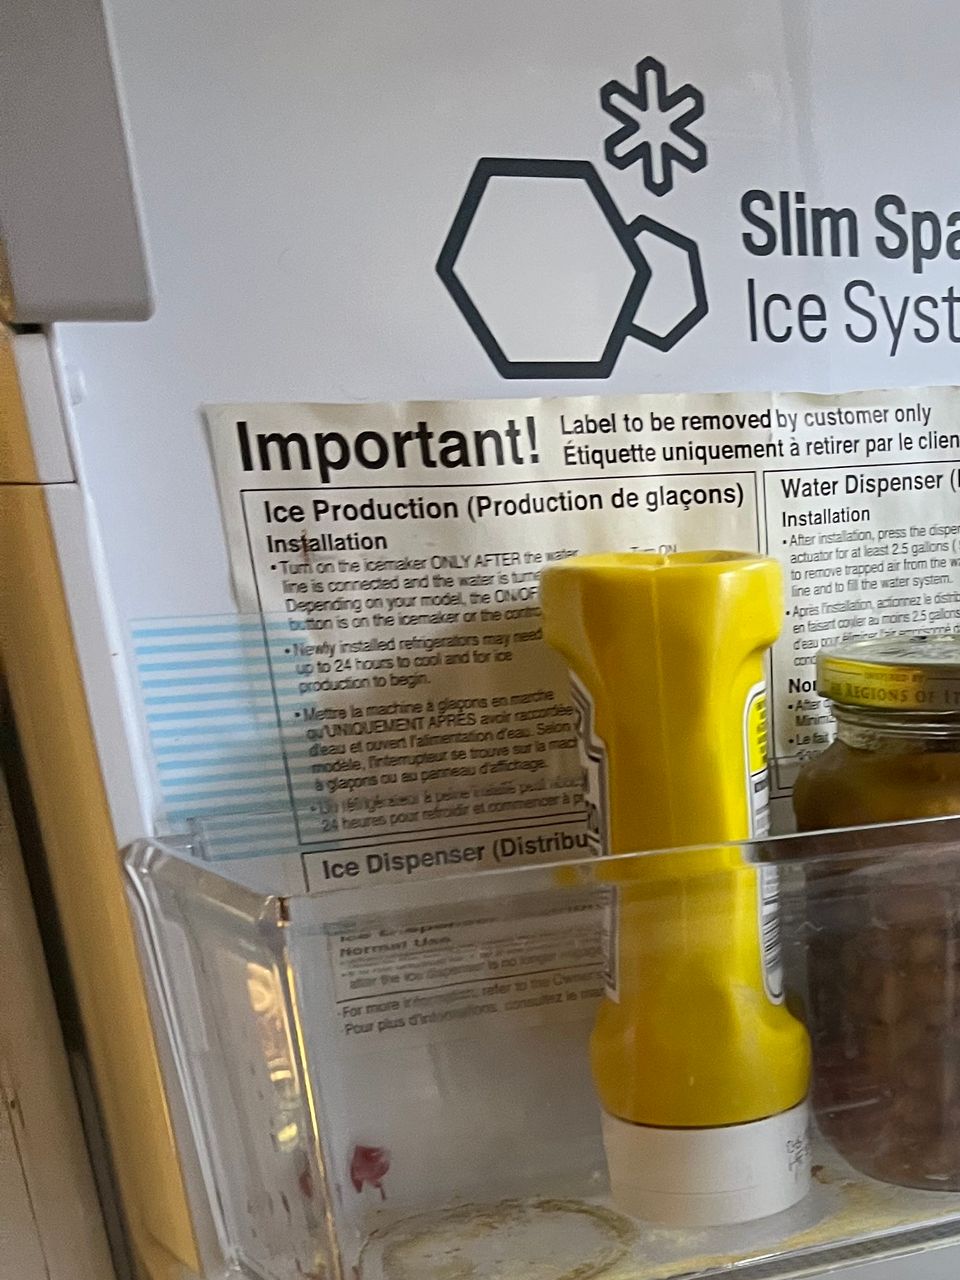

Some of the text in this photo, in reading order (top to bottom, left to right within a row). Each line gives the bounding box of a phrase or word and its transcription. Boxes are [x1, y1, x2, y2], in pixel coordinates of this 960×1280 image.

[741, 189, 858, 258] Slim
[747, 278, 827, 343] Ice
[561, 403, 931, 435] Label to be removed by customer only
[236, 416, 540, 484] Important!
[565, 440, 656, 469] Étiquette
[663, 438, 784, 465] uniquement
[790, 438, 801, 457] à
[806, 437, 859, 457] retirer
[866, 438, 893, 459] par
[899, 432, 913, 450] le
[782, 478, 838, 498] Water
[845, 472, 943, 500] Dispenser
[264, 483, 745, 524] Ice Production (Production de glaçons)
[782, 507, 870, 527] Installation
[267, 533, 388, 552] Installation
[790, 533, 815, 547] After
[878, 526, 906, 540] press
[909, 524, 926, 537] the
[280, 560, 309, 575] Turn
[316, 562, 335, 573] on
[338, 559, 360, 572] the
[363, 557, 427, 571] icemaker
[430, 554, 470, 570] ONLY
[474, 552, 520, 567] AFTER
[523, 551, 544, 563] the
[791, 569, 800, 580] to
[804, 565, 842, 579] remove
[845, 562, 884, 577] trapped
[887, 560, 900, 571] air
[903, 558, 927, 570] from
[930, 557, 946, 569] the
[791, 585, 810, 597] line
[814, 583, 832, 595] and
[835, 582, 843, 592] to
[860, 578, 877, 590] the
[880, 576, 909, 588] water
[913, 573, 954, 588] system.
[322, 857, 360, 880] Ice
[367, 843, 484, 875] Dispenser
